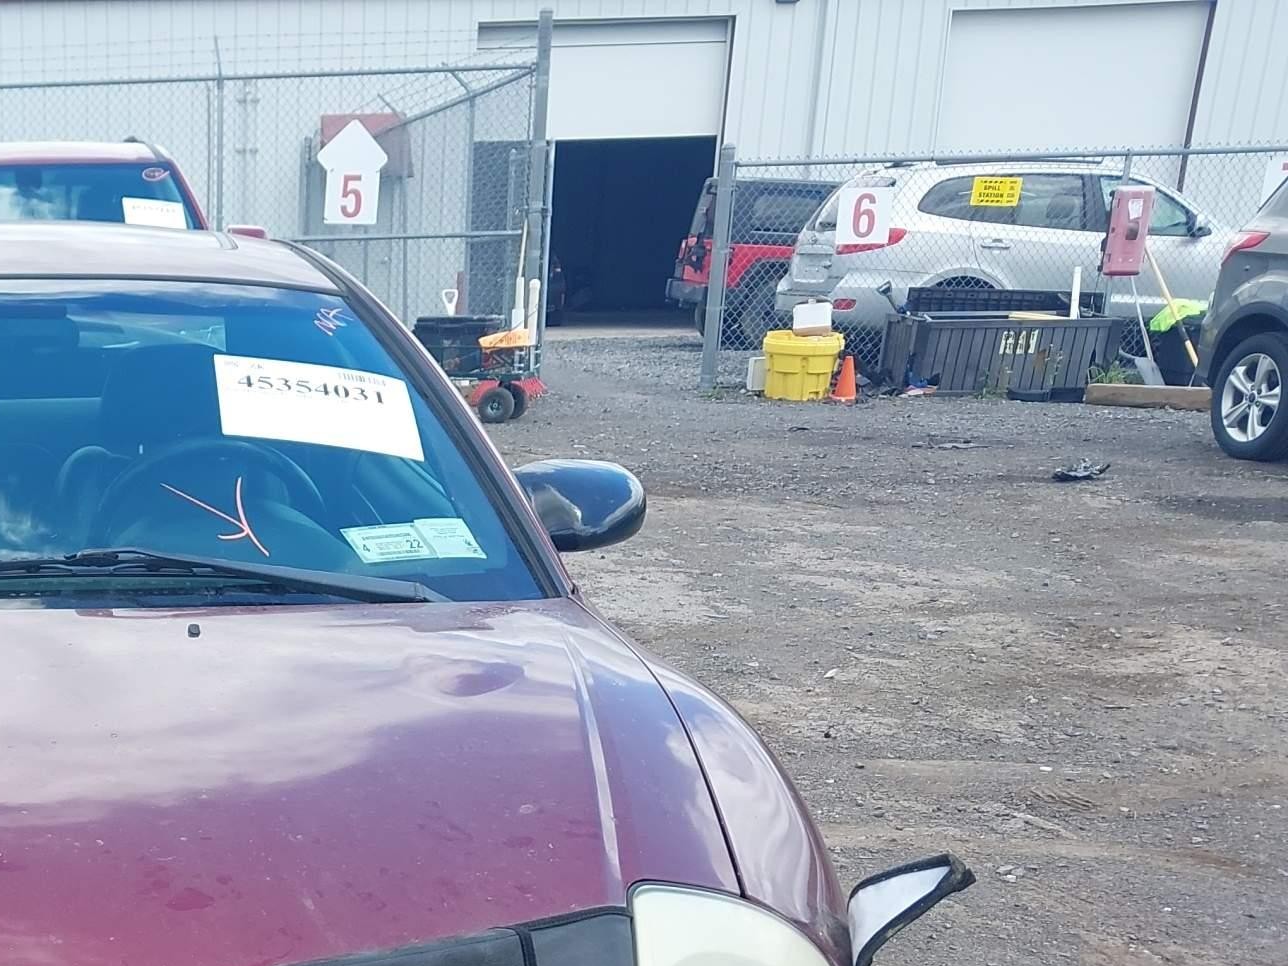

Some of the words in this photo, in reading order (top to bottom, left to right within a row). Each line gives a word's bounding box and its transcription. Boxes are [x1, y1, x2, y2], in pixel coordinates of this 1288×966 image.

[341, 174, 362, 218] 5
[853, 193, 876, 238] 6
[238, 375, 385, 404] 45354031
